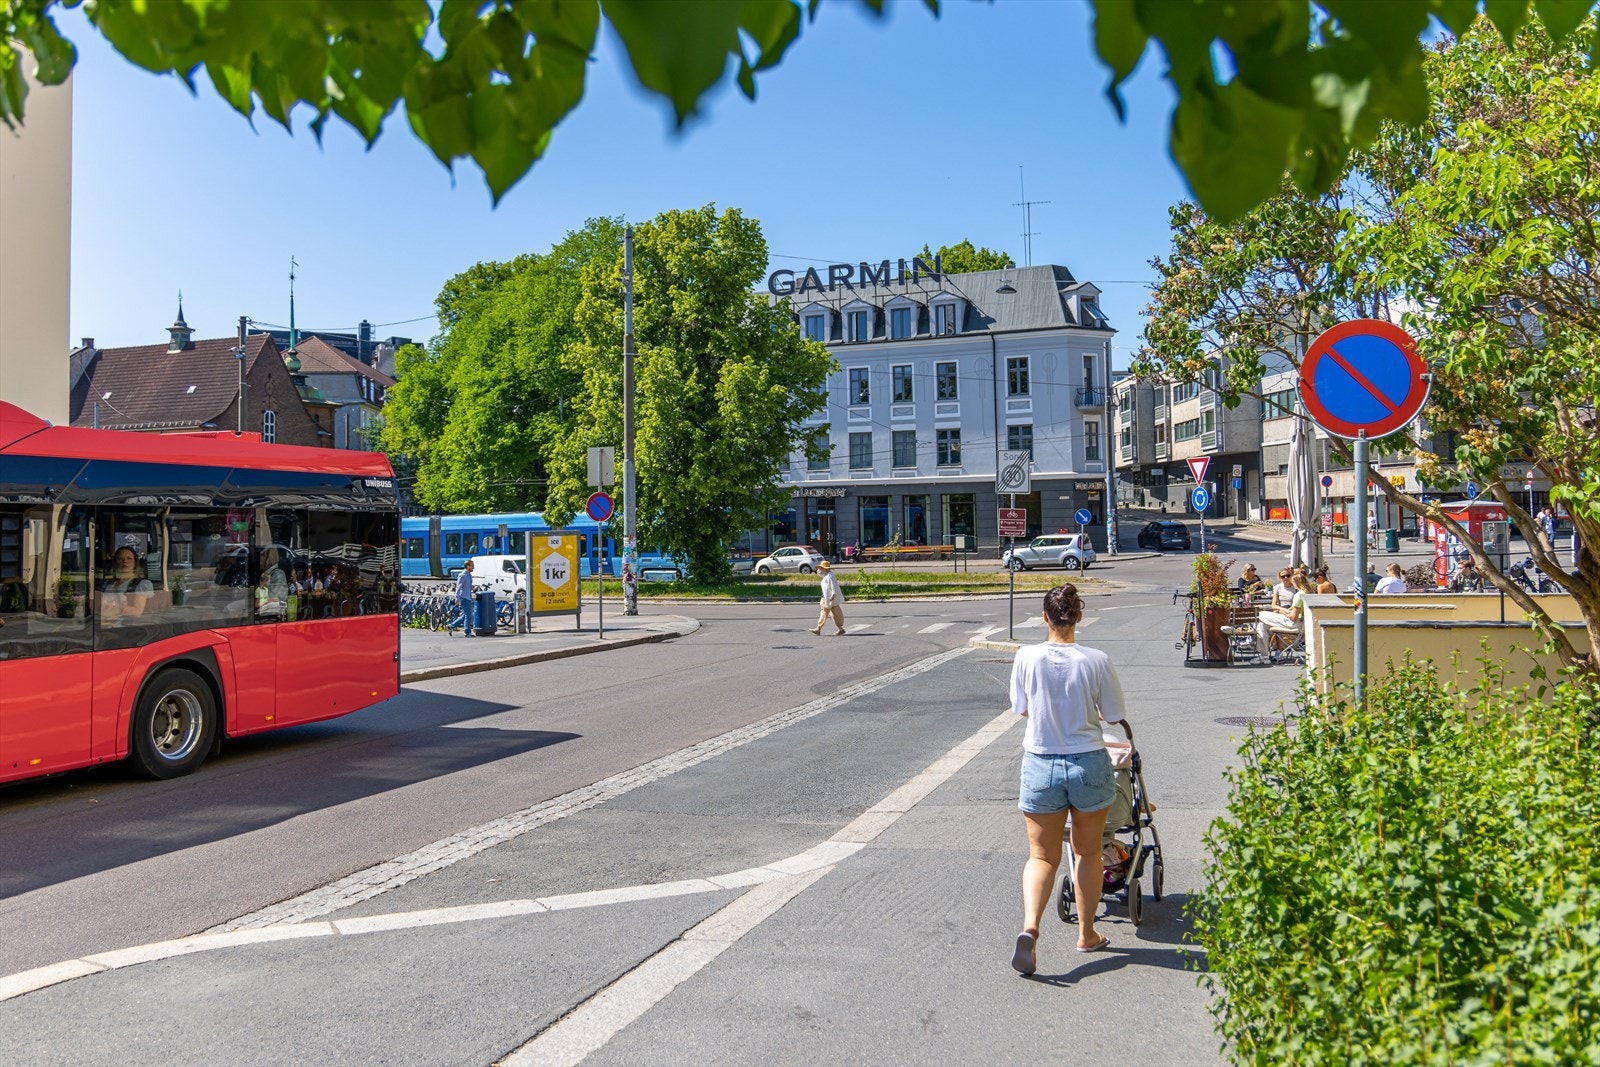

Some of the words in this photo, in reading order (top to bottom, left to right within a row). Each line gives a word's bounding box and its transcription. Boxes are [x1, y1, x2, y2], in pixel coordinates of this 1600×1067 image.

[768, 255, 942, 296] GARMIN
[545, 568, 550, 579] 1
[552, 568, 566, 579] kr
